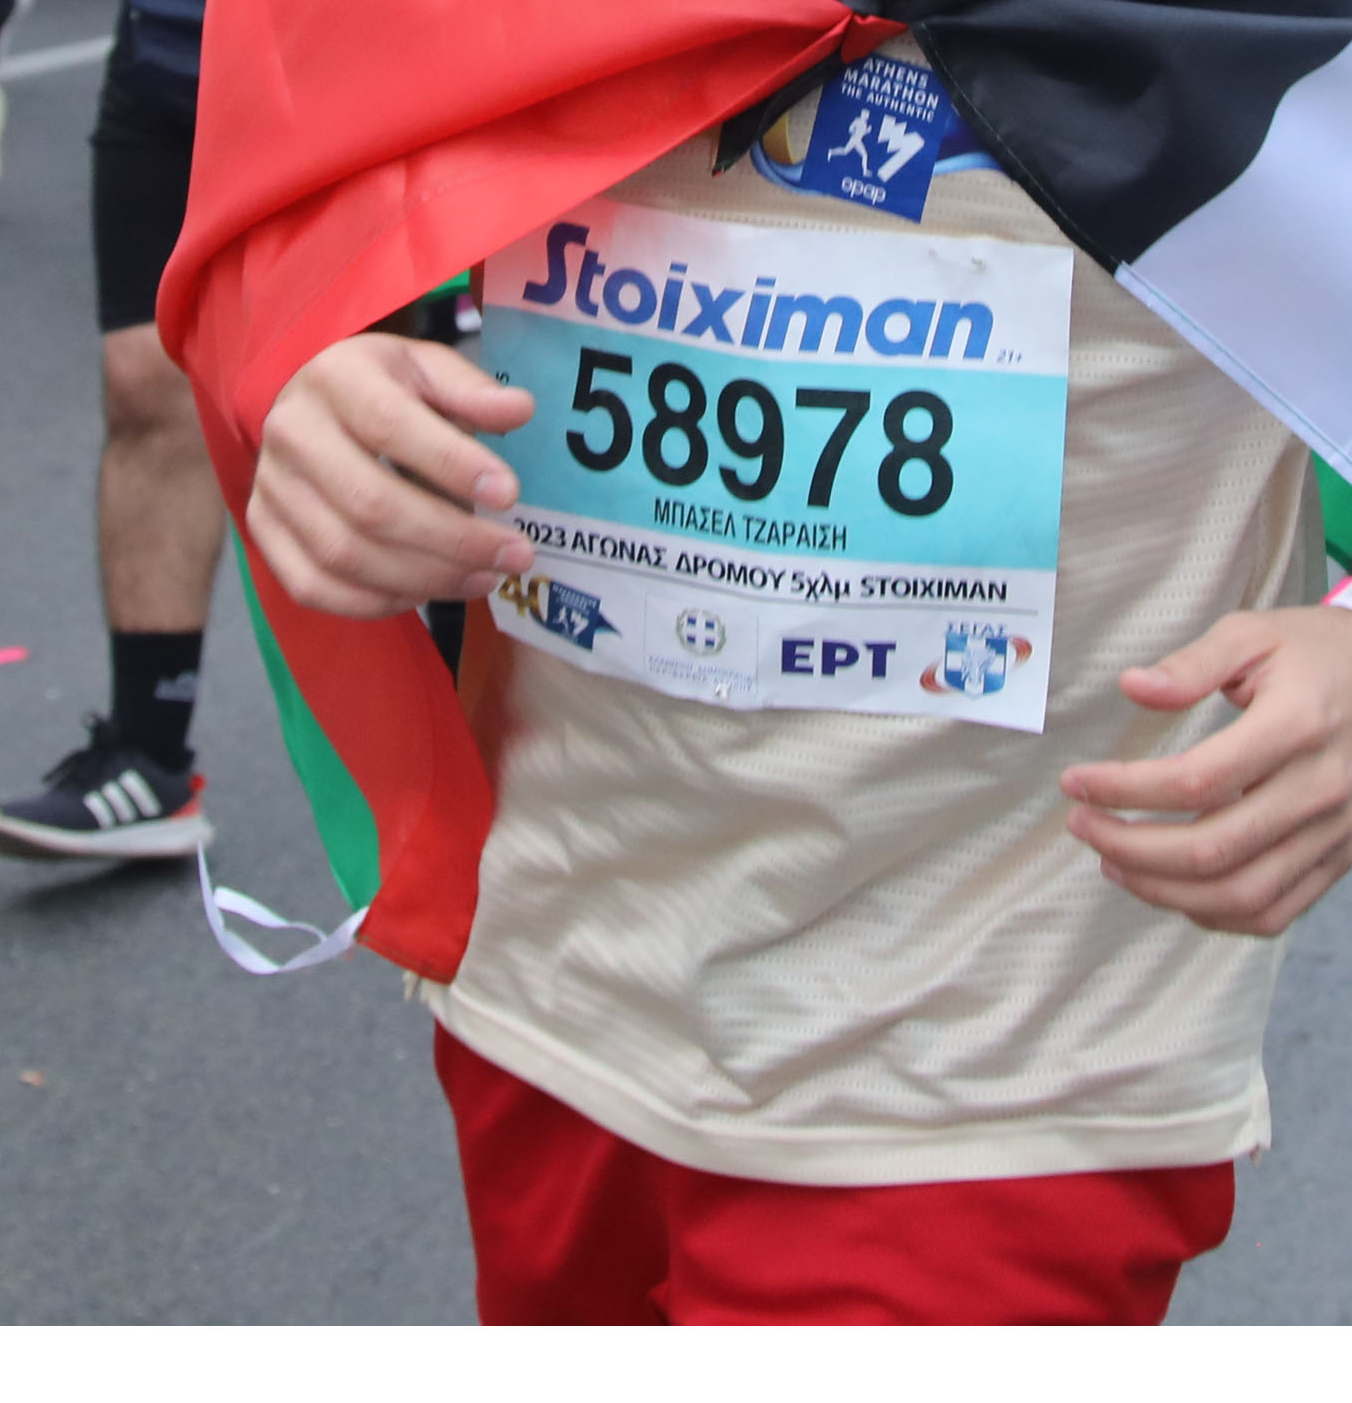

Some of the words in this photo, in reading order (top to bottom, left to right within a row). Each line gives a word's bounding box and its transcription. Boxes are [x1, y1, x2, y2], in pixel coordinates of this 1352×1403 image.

[843, 68, 939, 110] MARATHON
[863, 57, 928, 89] ATHENS
[841, 83, 863, 100] THE
[866, 92, 935, 124] AUTHENTIC
[841, 176, 886, 206] opap
[523, 222, 993, 360] Stoiximan
[566, 346, 954, 517] 58978
[654, 497, 736, 537] ΜΠΑΣΕΛ
[743, 515, 847, 551] ΤΖΑΡΑΙΣΗ
[514, 518, 567, 547] 2023
[571, 532, 667, 569] ΑΓΩΝΑΣ
[675, 551, 787, 591] ΔΡΟΜΟΥ
[791, 570, 850, 603] 5χλμ
[859, 576, 1008, 603] STOIXIMAN
[781, 638, 897, 679] ΕΡΤ
